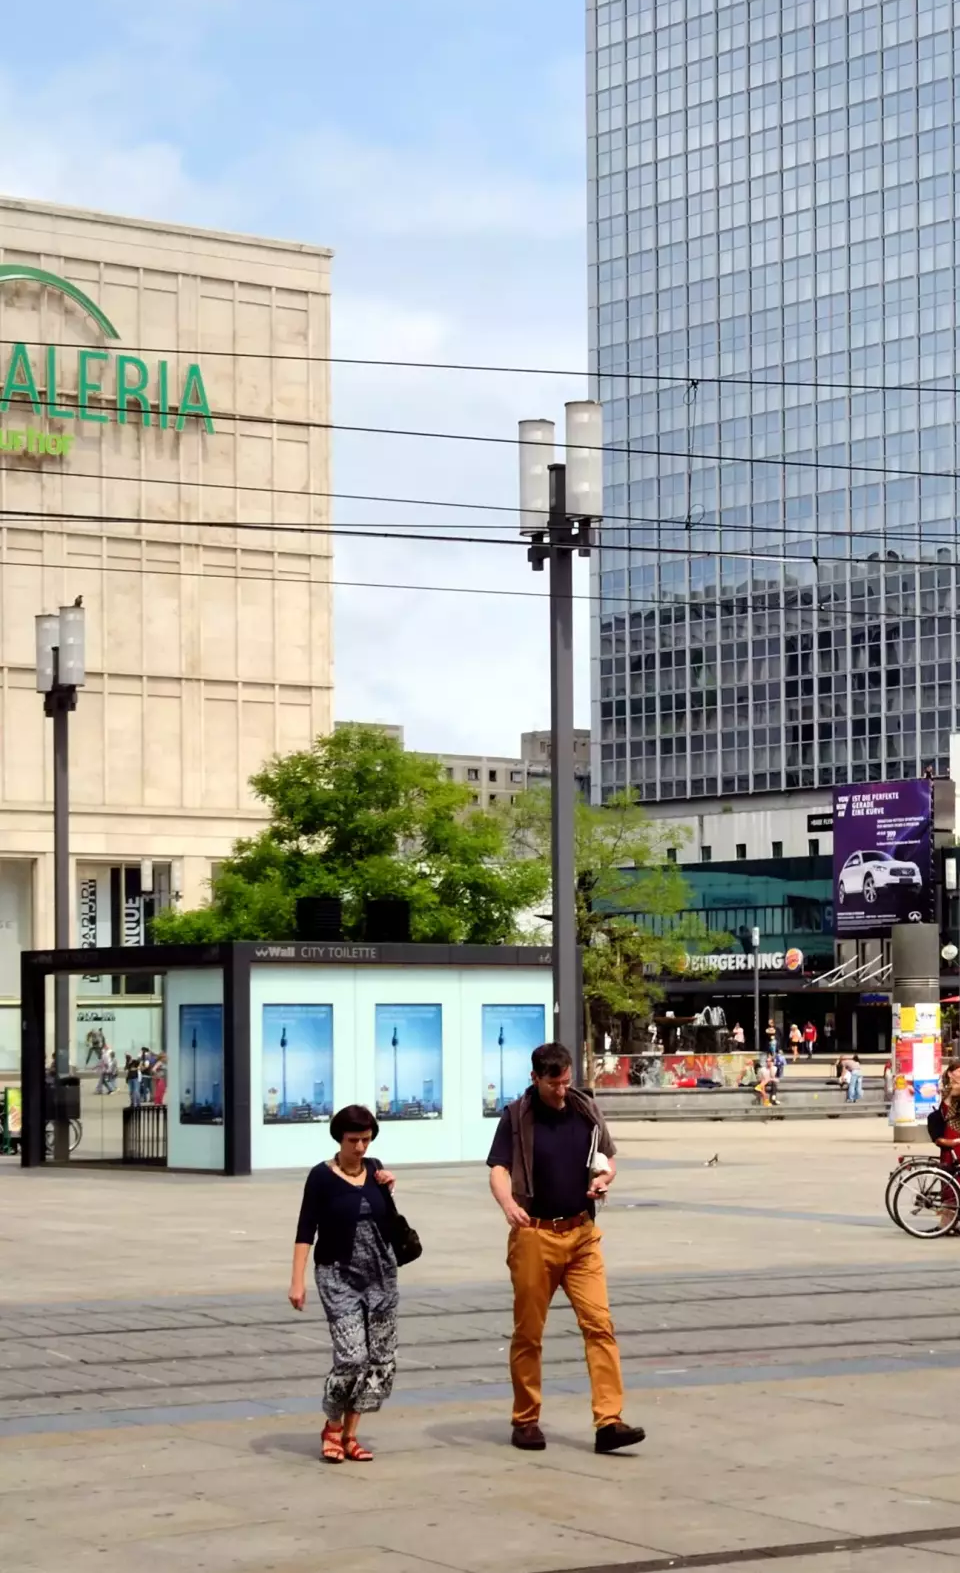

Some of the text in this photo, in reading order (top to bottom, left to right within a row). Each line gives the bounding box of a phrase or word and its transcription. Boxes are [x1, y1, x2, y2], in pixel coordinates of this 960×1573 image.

[872, 792, 899, 800] PERFEKTE
[851, 801, 874, 809] GERADE
[866, 807, 884, 815] KURVE
[301, 947, 325, 958] CITY
[328, 947, 377, 958] TOILETTE
[690, 953, 746, 970] BURGER
